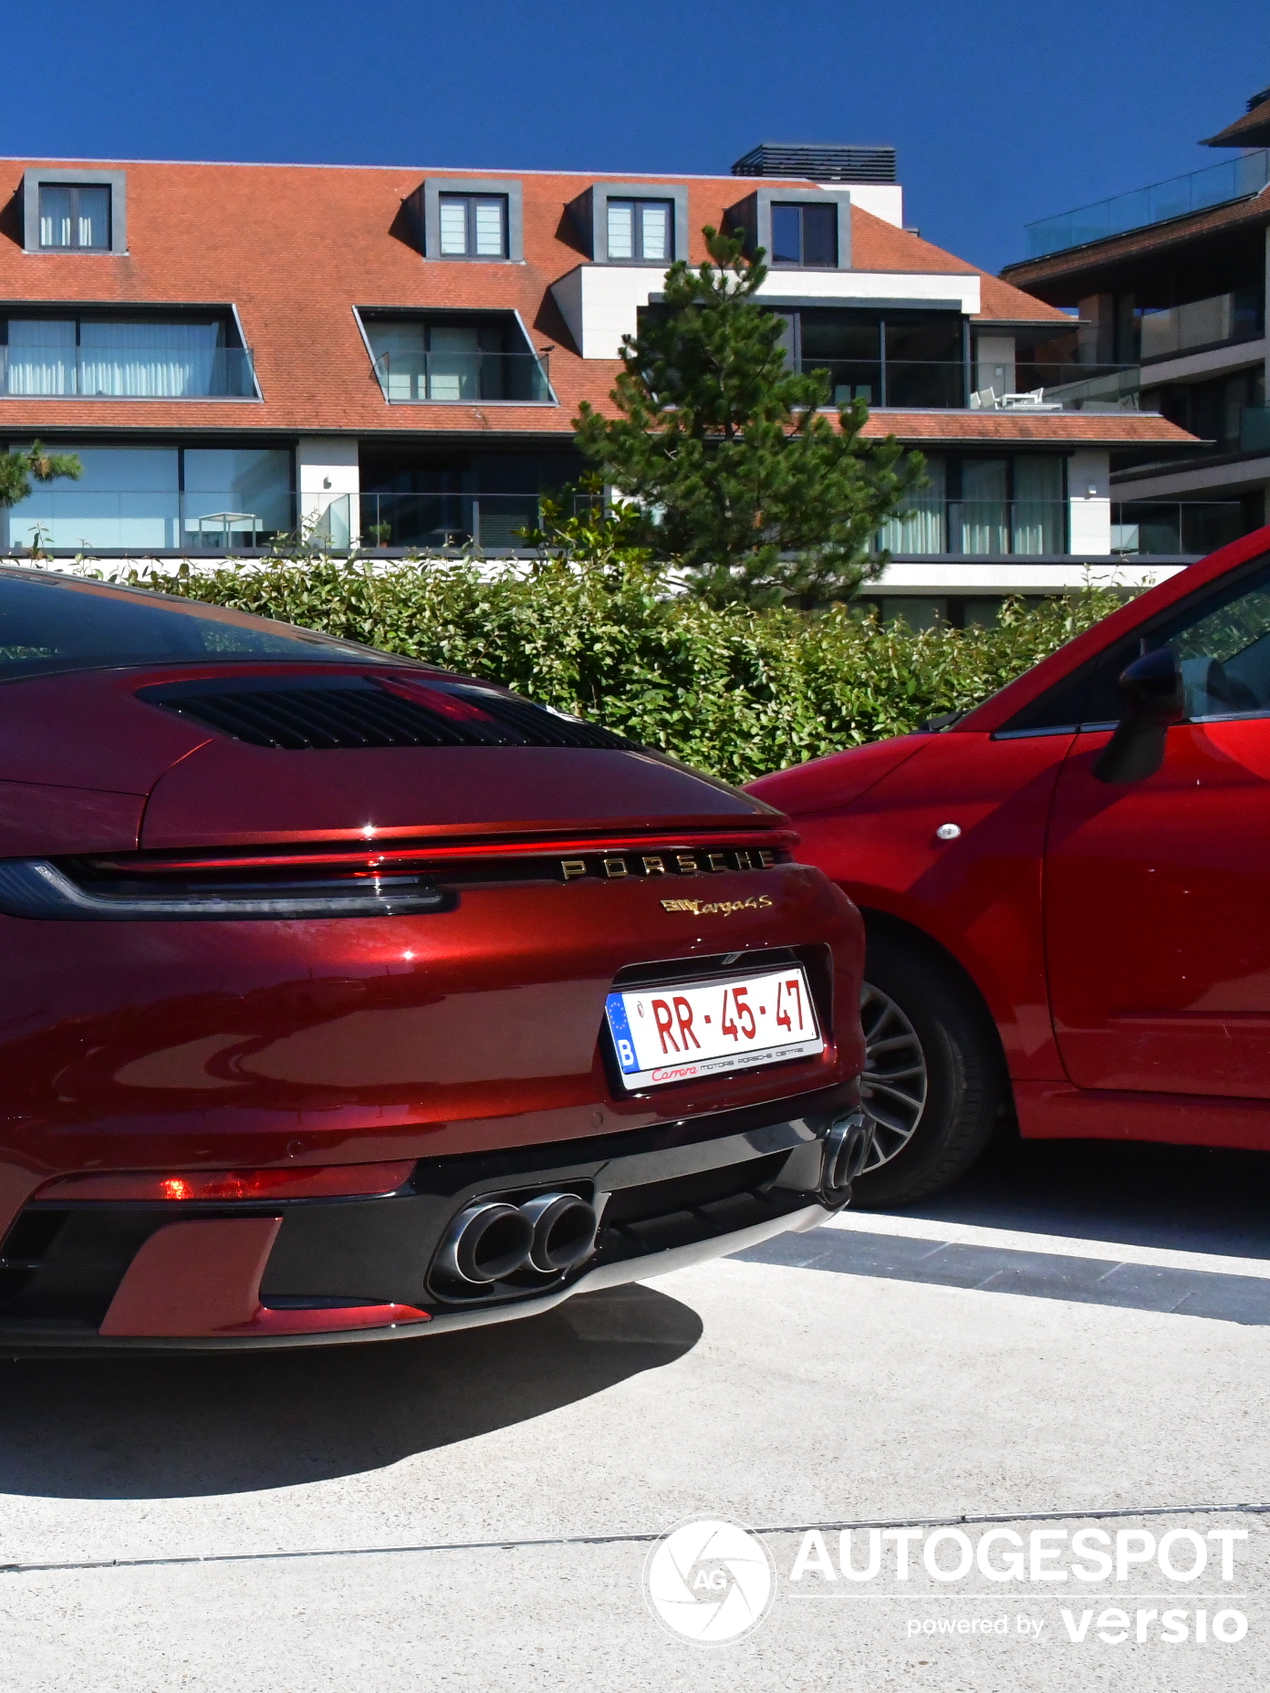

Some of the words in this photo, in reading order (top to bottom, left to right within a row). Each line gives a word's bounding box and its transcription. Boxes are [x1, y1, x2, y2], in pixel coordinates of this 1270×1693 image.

[560, 850, 775, 880] PORSCHE
[618, 1039, 634, 1067] B
[651, 1065, 699, 1082] Carrera
[700, 1060, 735, 1070] MOTORS
[737, 1052, 773, 1064] PORSCHE
